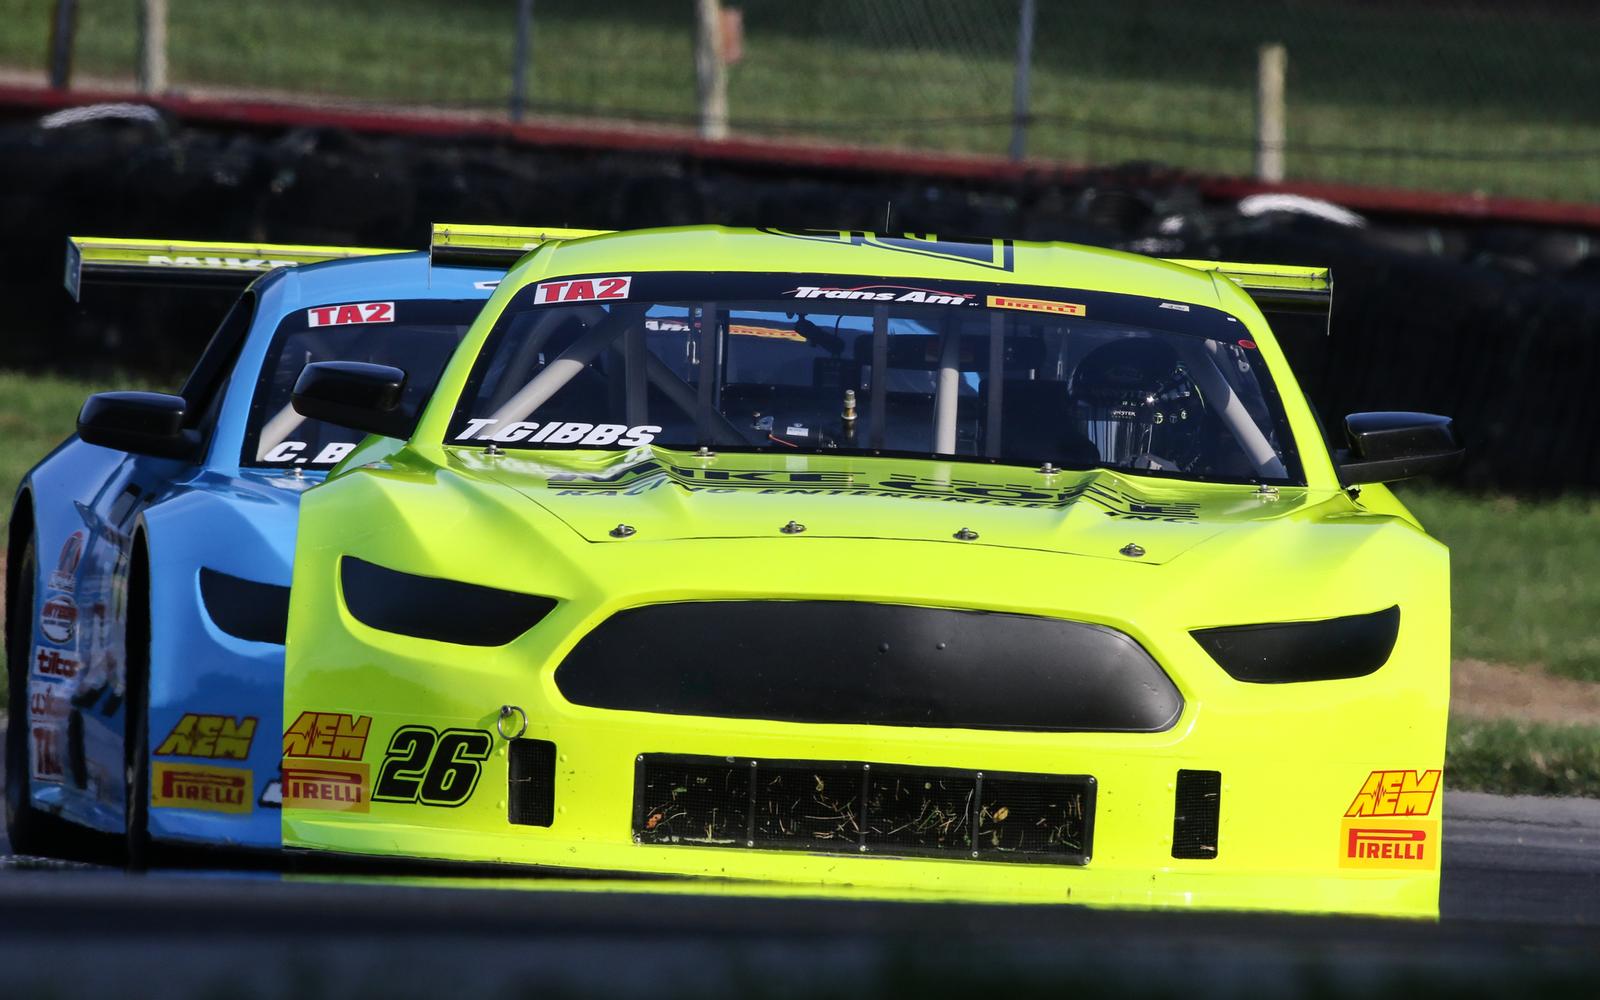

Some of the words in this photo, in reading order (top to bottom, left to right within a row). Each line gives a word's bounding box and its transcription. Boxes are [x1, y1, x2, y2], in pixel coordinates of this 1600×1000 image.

[541, 278, 627, 302] TA2
[795, 287, 895, 301] Trans
[895, 291, 966, 306] Am
[311, 303, 392, 325] TA2
[152, 712, 258, 762] AEM
[283, 711, 372, 761] AEM
[370, 724, 494, 808] 26
[162, 771, 245, 805] PIRELLI
[283, 768, 362, 803] PIRELLI
[1344, 769, 1442, 817] AEM
[1347, 828, 1426, 860] PIRELLI
